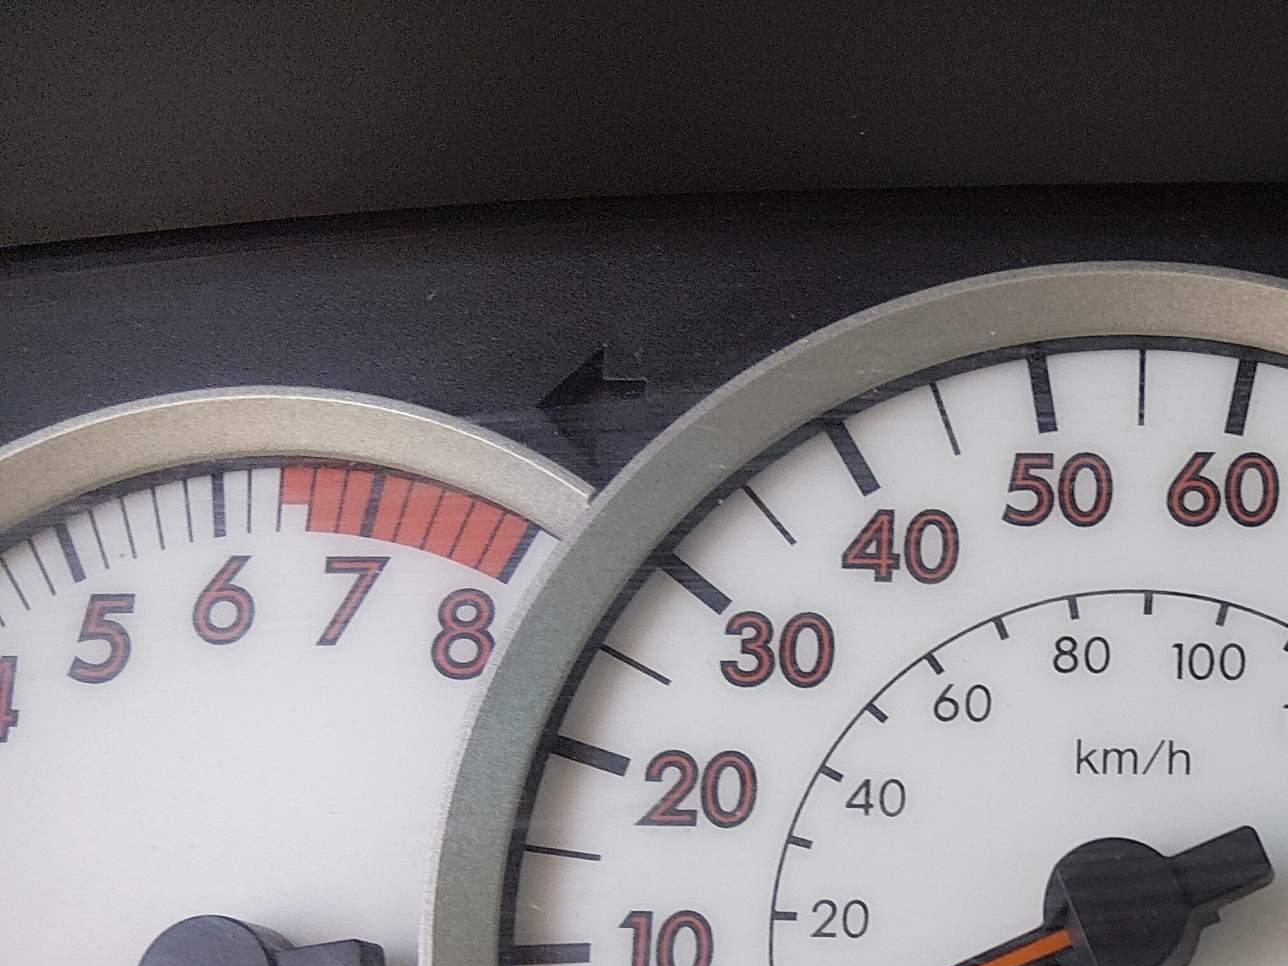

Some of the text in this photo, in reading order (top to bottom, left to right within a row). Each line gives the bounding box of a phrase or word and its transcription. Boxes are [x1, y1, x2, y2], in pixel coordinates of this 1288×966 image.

[1002, 452, 1113, 528] 50
[1166, 451, 1280, 528] 60
[840, 508, 960, 585] 40
[193, 554, 254, 646] 6
[316, 556, 391, 646] 7
[430, 587, 496, 681] 8
[67, 593, 135, 685] 5
[720, 611, 836, 689] 30
[1052, 636, 1111, 675] 80
[1172, 642, 1246, 681] 100
[932, 684, 993, 724] 60
[634, 749, 758, 829] 20
[1074, 738, 1192, 778] km/h
[844, 777, 906, 818] 40
[810, 899, 870, 939] 20
